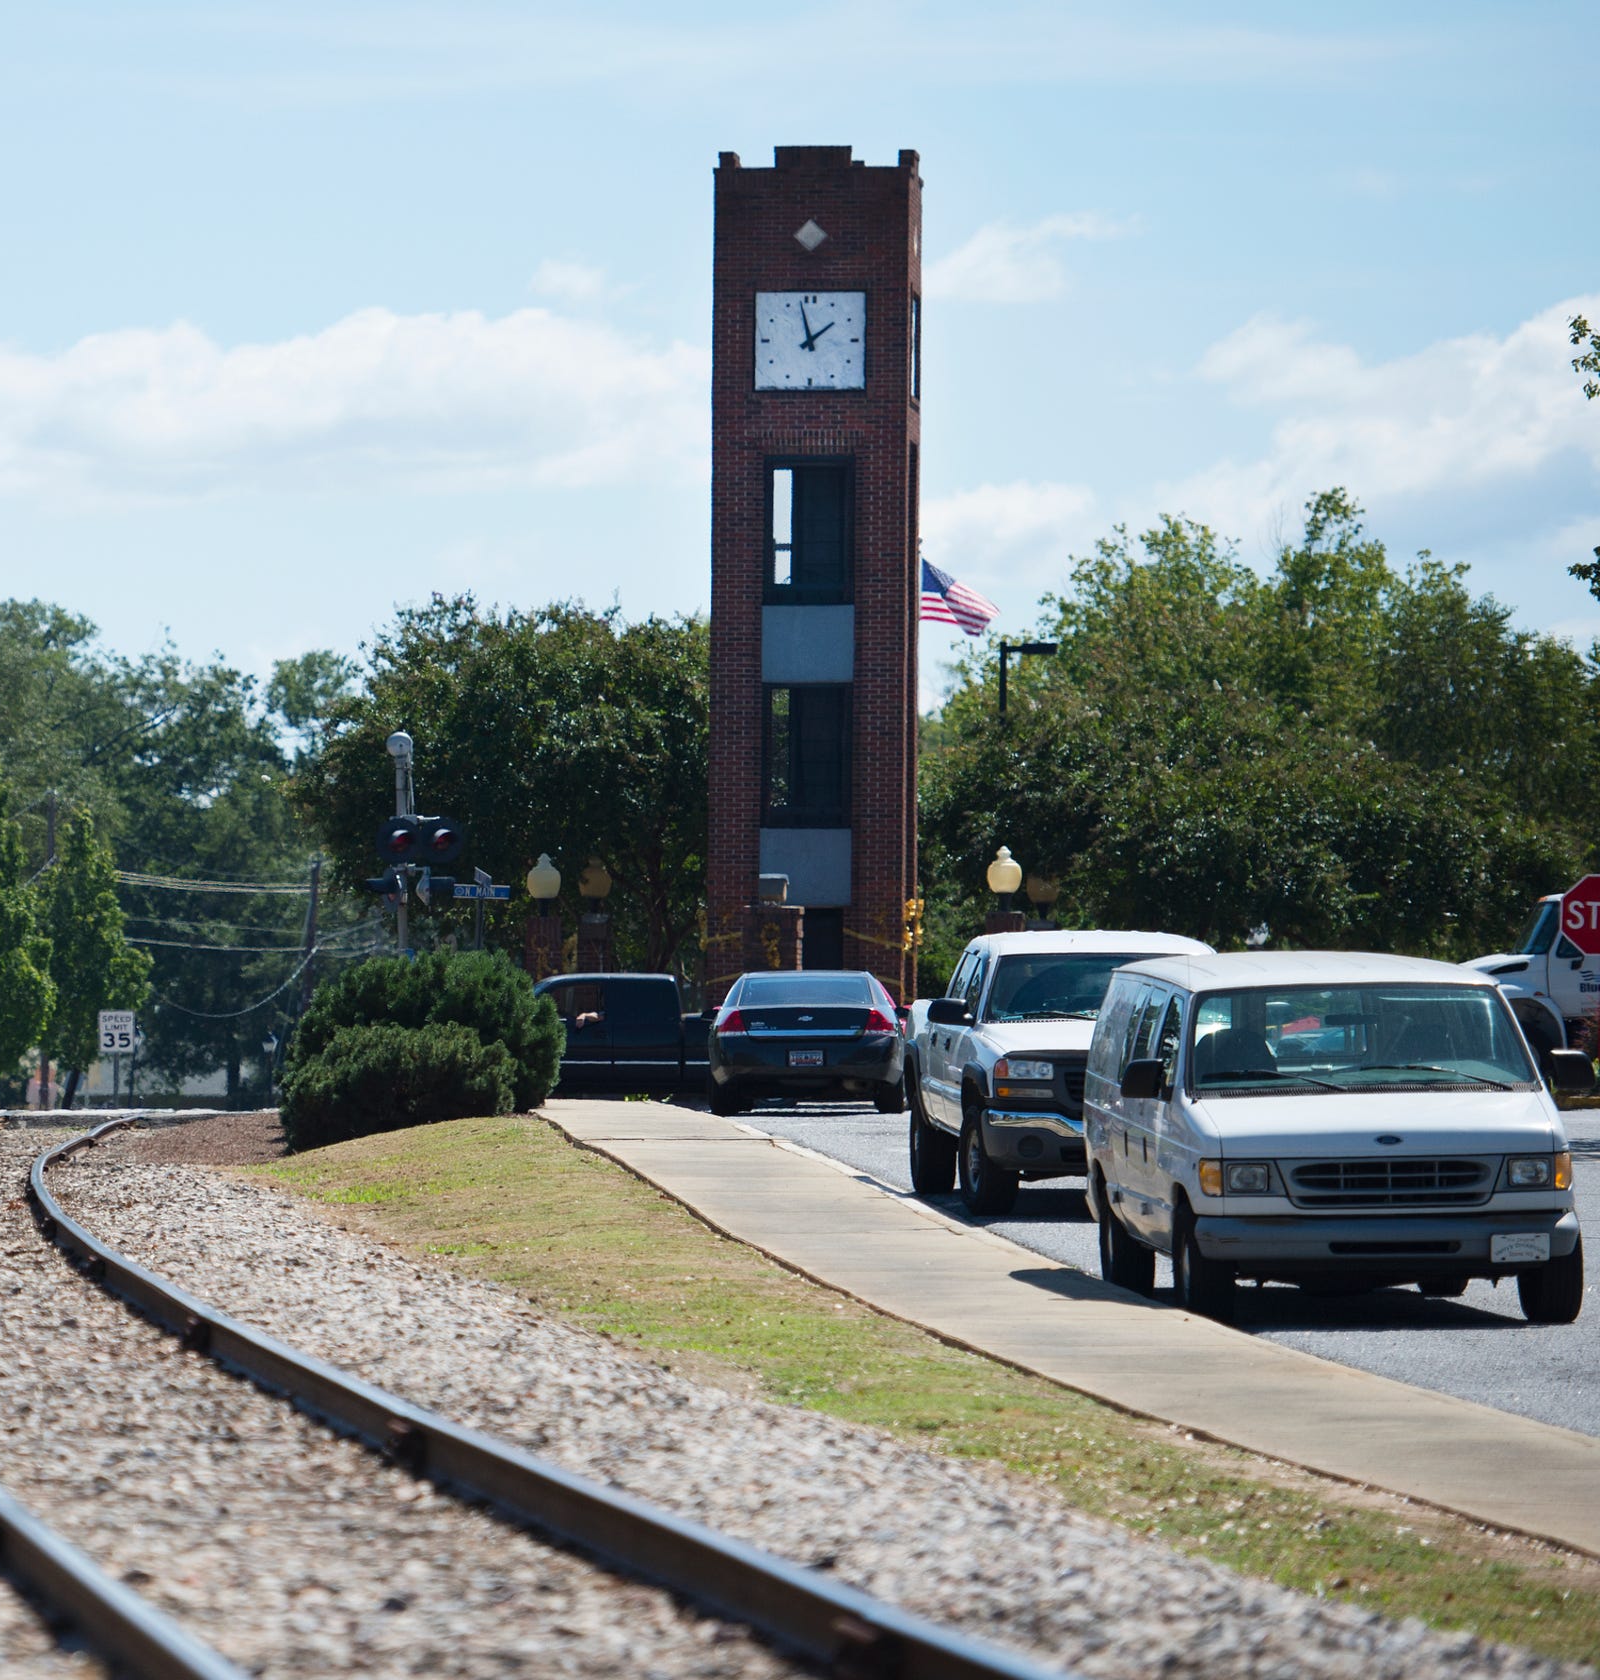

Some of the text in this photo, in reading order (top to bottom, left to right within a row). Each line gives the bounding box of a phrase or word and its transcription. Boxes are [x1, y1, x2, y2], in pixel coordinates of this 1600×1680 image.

[476, 887, 496, 897] MAIN
[102, 1015, 132, 1023] SPEED
[103, 1032, 131, 1048] 35
